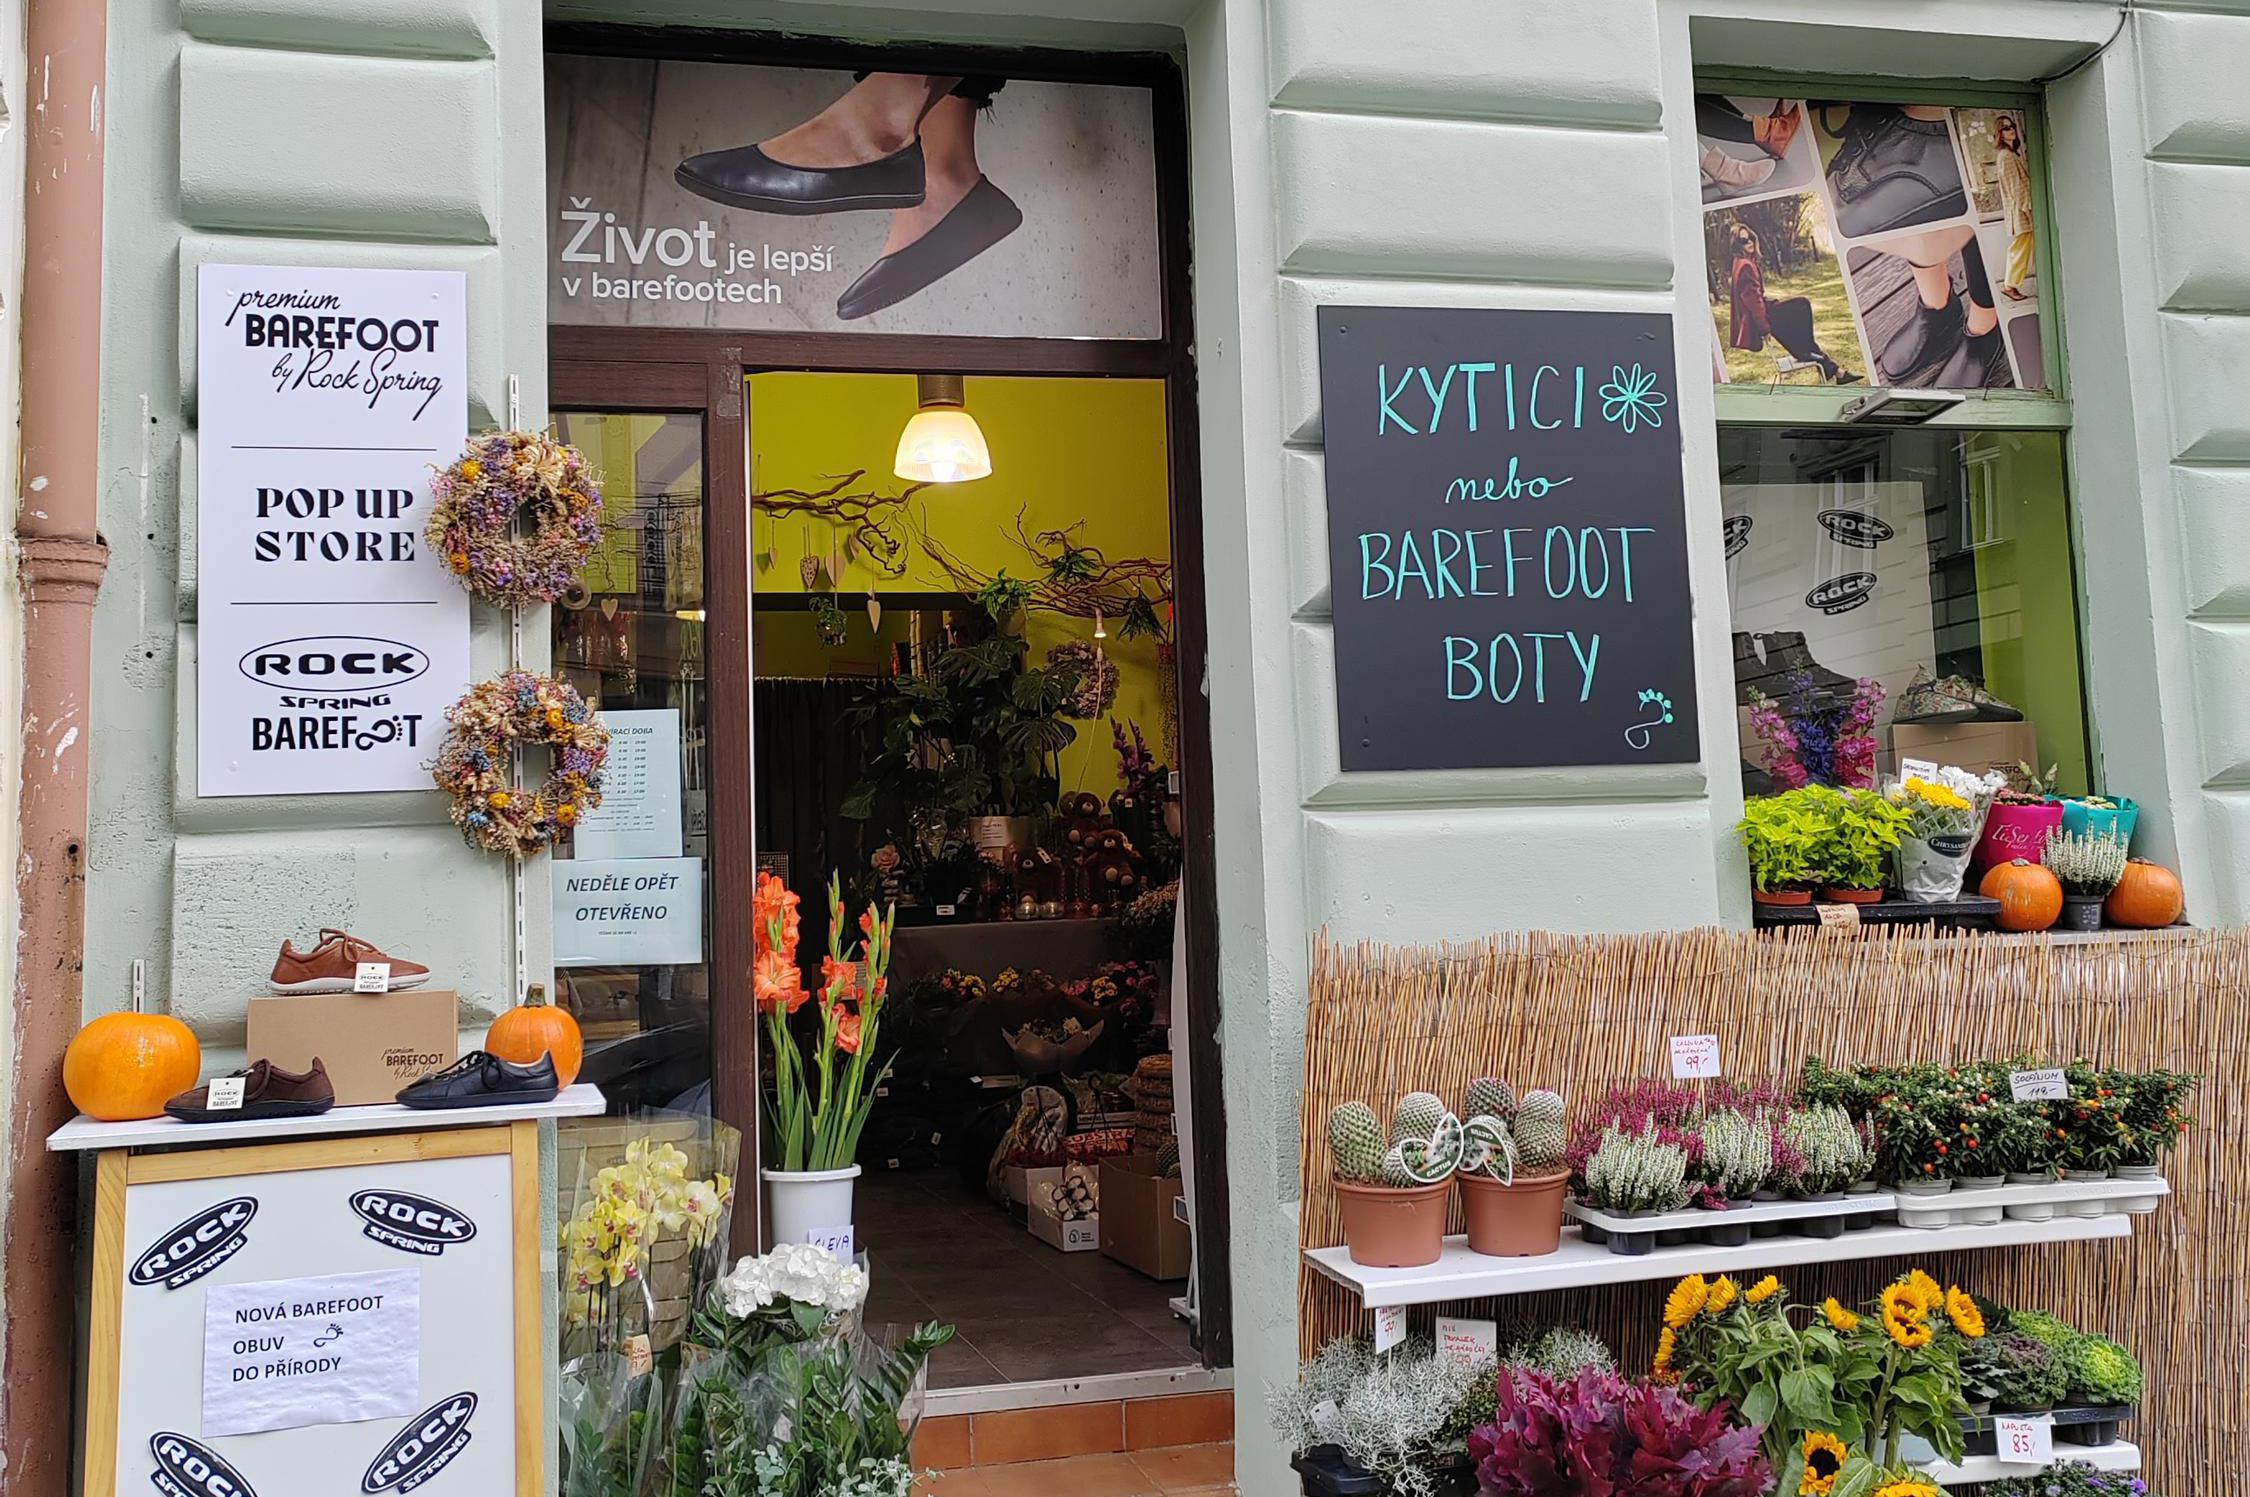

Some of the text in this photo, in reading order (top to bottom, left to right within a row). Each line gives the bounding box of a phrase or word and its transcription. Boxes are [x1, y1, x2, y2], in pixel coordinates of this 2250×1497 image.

[561, 196, 836, 276] Život je lepší
[562, 271, 782, 304] v barefootech
[226, 289, 340, 327] premium
[244, 313, 439, 353] BAREFOOT
[271, 347, 443, 421] by Rock Spring
[1378, 362, 1584, 436] KYTICI
[1444, 456, 1575, 504] nebo
[255, 486, 414, 520] POP UP
[1825, 513, 1886, 537] ROCK
[254, 530, 416, 563] STORE
[1358, 525, 1656, 603] BAREFOOT
[1811, 576, 1872, 605] ROCK
[254, 651, 416, 676] ROCK
[1443, 630, 1601, 704] BOTY
[279, 694, 391, 710] SPRING
[566, 872, 680, 892] NEDĚLE OPĚT
[575, 903, 668, 921] OTEVŘENO
[386, 1053, 444, 1067] BAREFOOT
[1471, 1127, 1494, 1140] CACTUS
[1426, 1160, 1452, 1178] CACTUS
[361, 1193, 467, 1238] ROCK
[140, 1203, 248, 1278] ROCK
[367, 1224, 441, 1254] SPRING
[169, 1236, 243, 1288] SPRING
[235, 1295, 384, 1324] NOVÁ BAREFOOT
[232, 1335, 286, 1355] OBUV
[232, 1356, 342, 1382] DO PŘÍRODY
[373, 1400, 469, 1488] ROCK
[160, 1439, 243, 1497] ROC
[402, 1432, 469, 1493] SPRING
